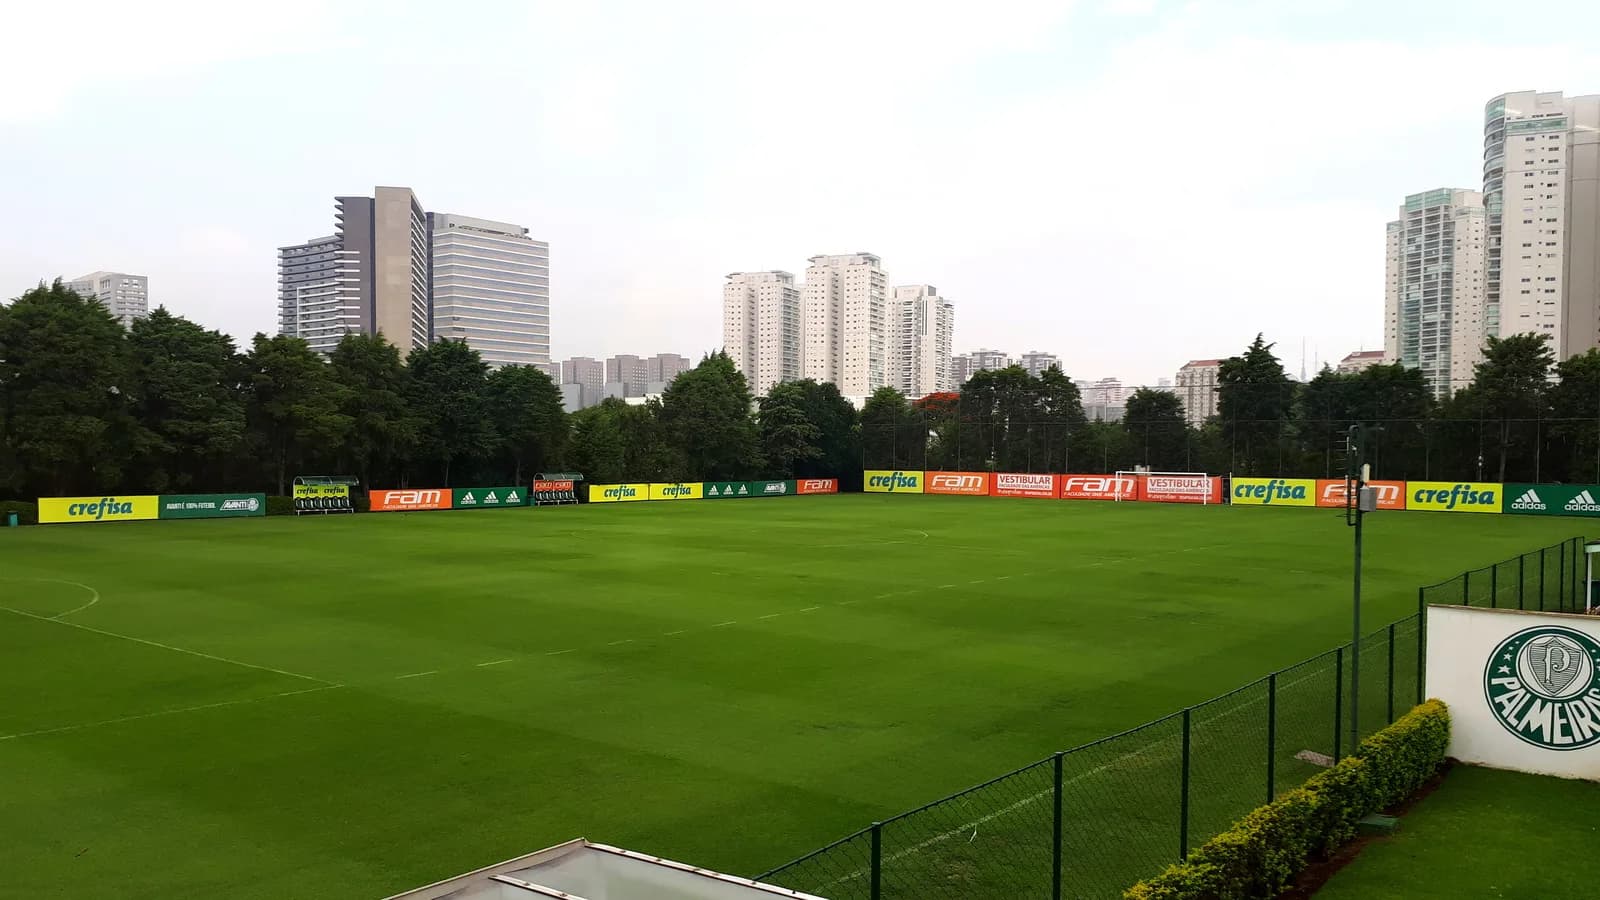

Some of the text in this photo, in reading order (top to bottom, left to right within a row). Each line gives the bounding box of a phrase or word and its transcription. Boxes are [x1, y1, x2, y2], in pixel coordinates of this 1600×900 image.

[869, 471, 918, 491] crefisa
[999, 475, 1051, 485] VESTIBULAR
[1149, 478, 1210, 488] VESTIBULAR
[603, 485, 636, 500] crefisa
[662, 482, 692, 498] crefisa
[1234, 480, 1306, 504] crefisa
[1414, 484, 1495, 509] crefisa
[68, 497, 133, 520] crefisa
[1511, 501, 1546, 510] adidas
[1564, 503, 1600, 511] adidas
